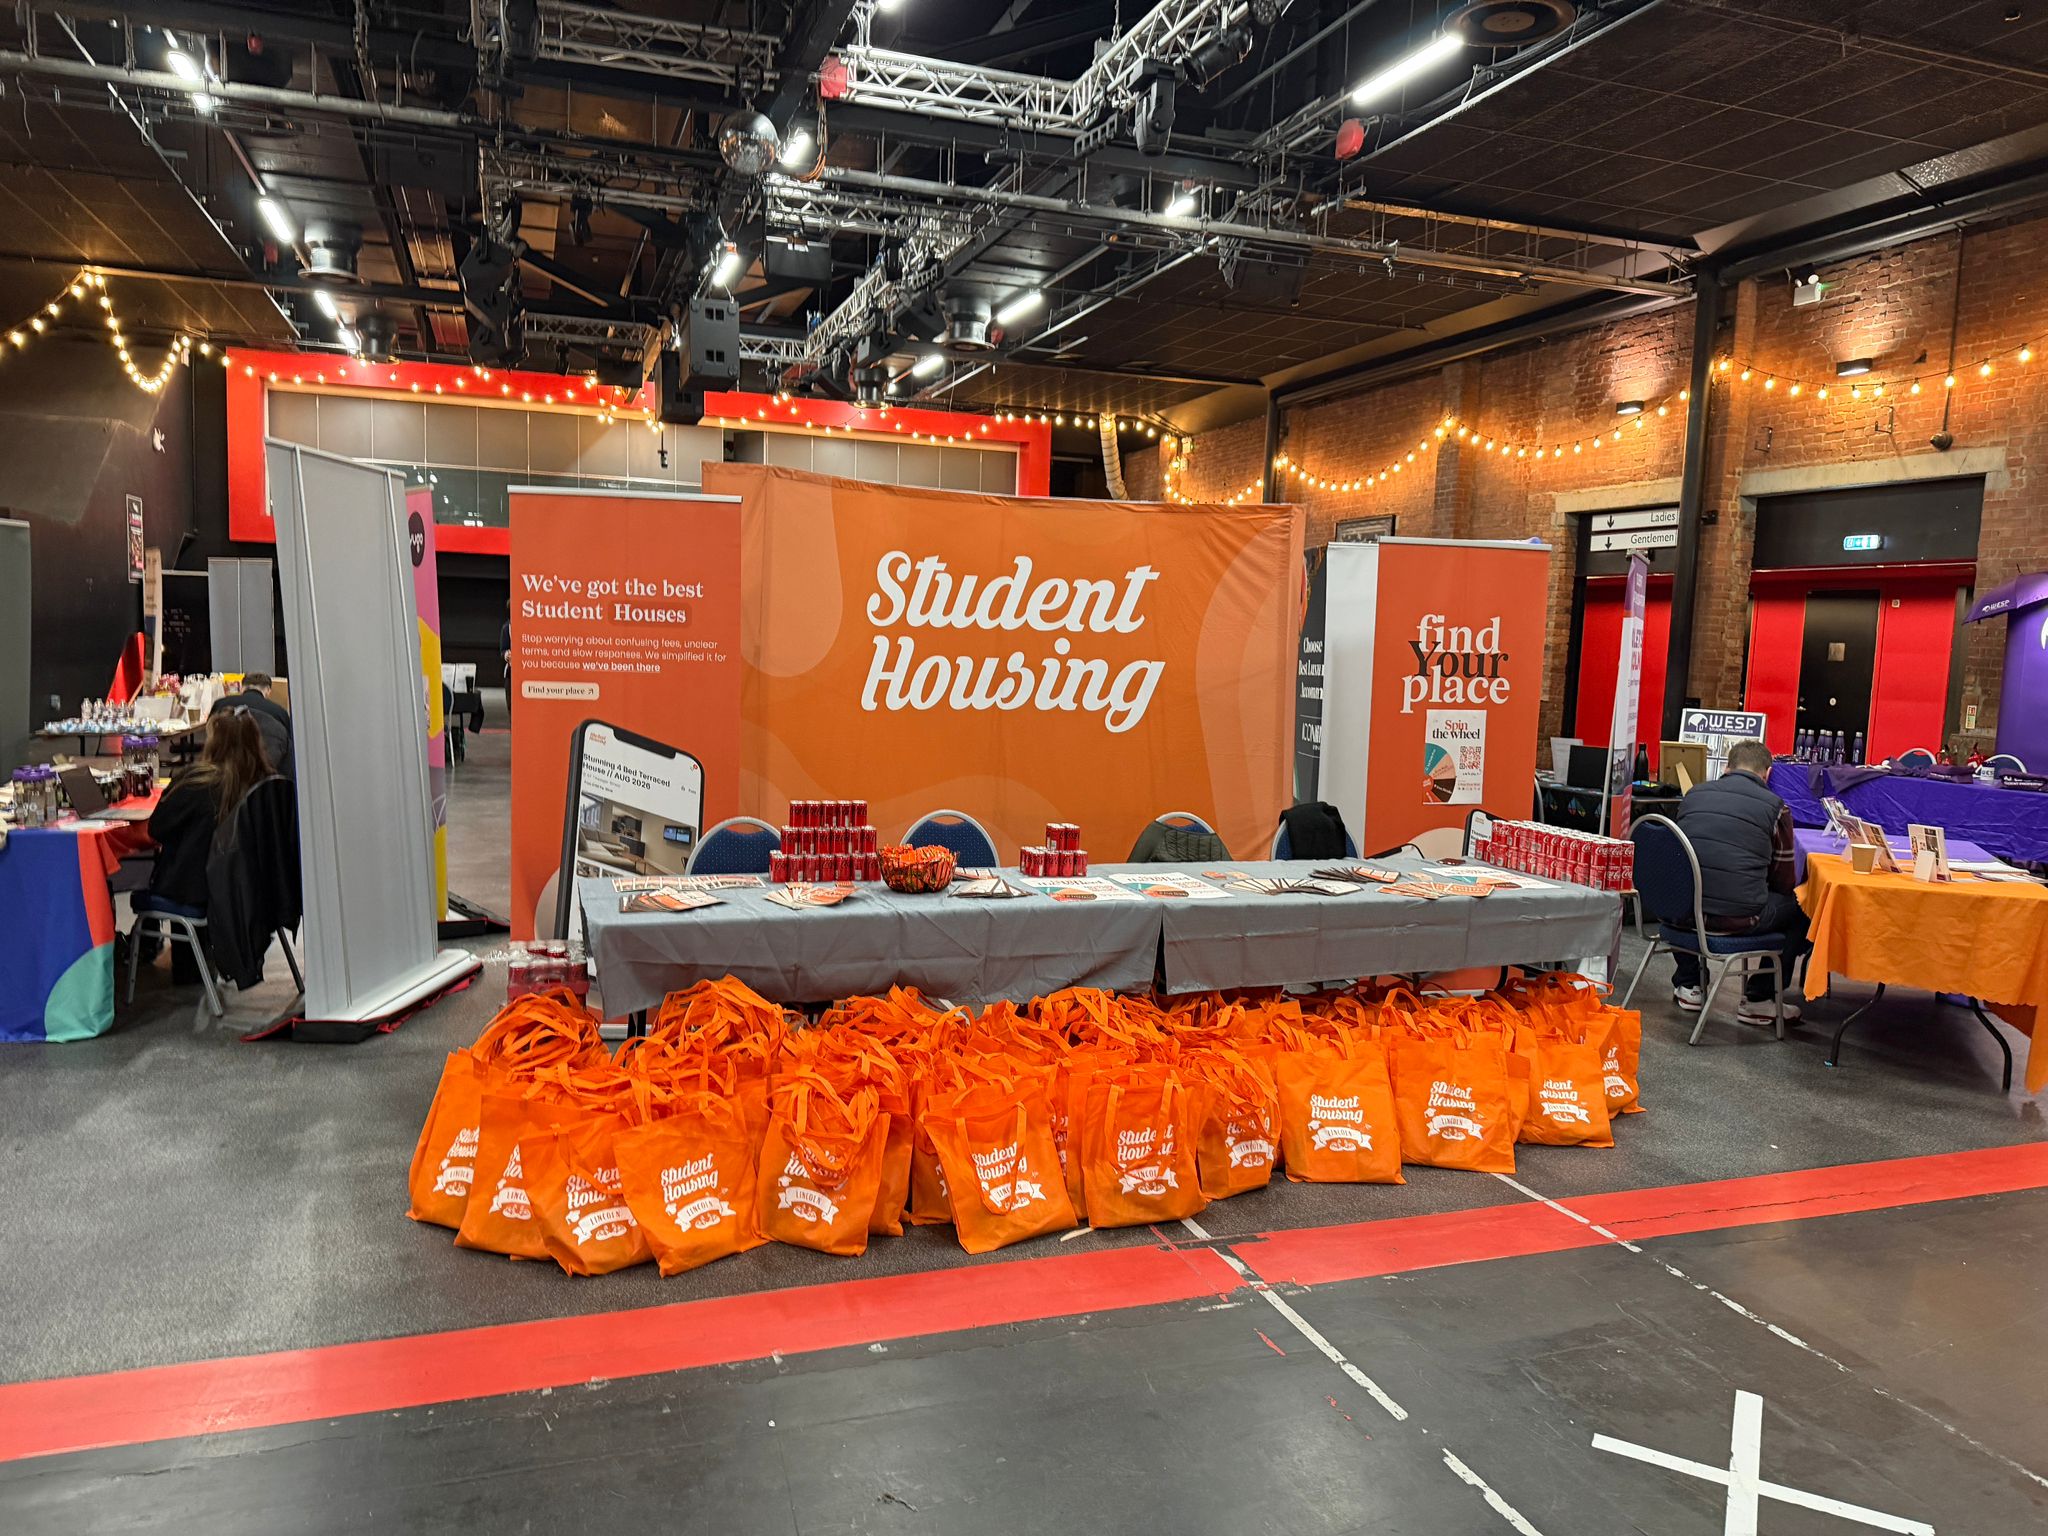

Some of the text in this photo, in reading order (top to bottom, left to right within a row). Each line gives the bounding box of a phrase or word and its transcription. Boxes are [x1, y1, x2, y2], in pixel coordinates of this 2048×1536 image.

[1650, 511, 1676, 523] Ladies
[1630, 532, 1675, 544] Gentlemen
[521, 574, 703, 599] We've got the best
[866, 550, 1161, 634] Student
[522, 600, 686, 623] Student Houses
[1990, 599, 2010, 610] WESP
[522, 634, 718, 649] Stop worrying about confusing fees, unclear
[1416, 614, 1501, 654] find
[552, 647, 570, 657] and
[572, 648, 593, 657] slow
[645, 650, 660, 659] We
[662, 650, 704, 662] simplified
[706, 652, 712, 661] it
[715, 653, 727, 662] for
[1408, 641, 1509, 678] Your
[521, 660, 538, 670] you
[541, 660, 580, 670] because
[582, 661, 609, 671] we've
[611, 662, 634, 671] been
[528, 685, 586, 696] Find your place
[861, 635, 1166, 733] Housing
[1400, 664, 1510, 713] place
[1445, 719, 1468, 731] Spin
[1709, 714, 1757, 730] WESP
[1432, 728, 1480, 739] the wheel
[582, 761, 606, 775] House
[614, 771, 631, 783] AUG
[632, 778, 651, 790] 2026
[583, 753, 615, 769] Stunning
[623, 765, 637, 776] Bed
[639, 770, 671, 788] Terraced
[1310, 1094, 1359, 1108] Student
[1311, 1106, 1363, 1124] Housing
[1117, 1124, 1173, 1146] Studet
[1327, 1129, 1352, 1137] LINCOLN
[661, 1152, 713, 1186] Student
[663, 1169, 718, 1203] Housing
[795, 1190, 821, 1205] LINCOLN
[687, 1200, 713, 1216] LINCOLN
[590, 1210, 621, 1226] LINCOLN
